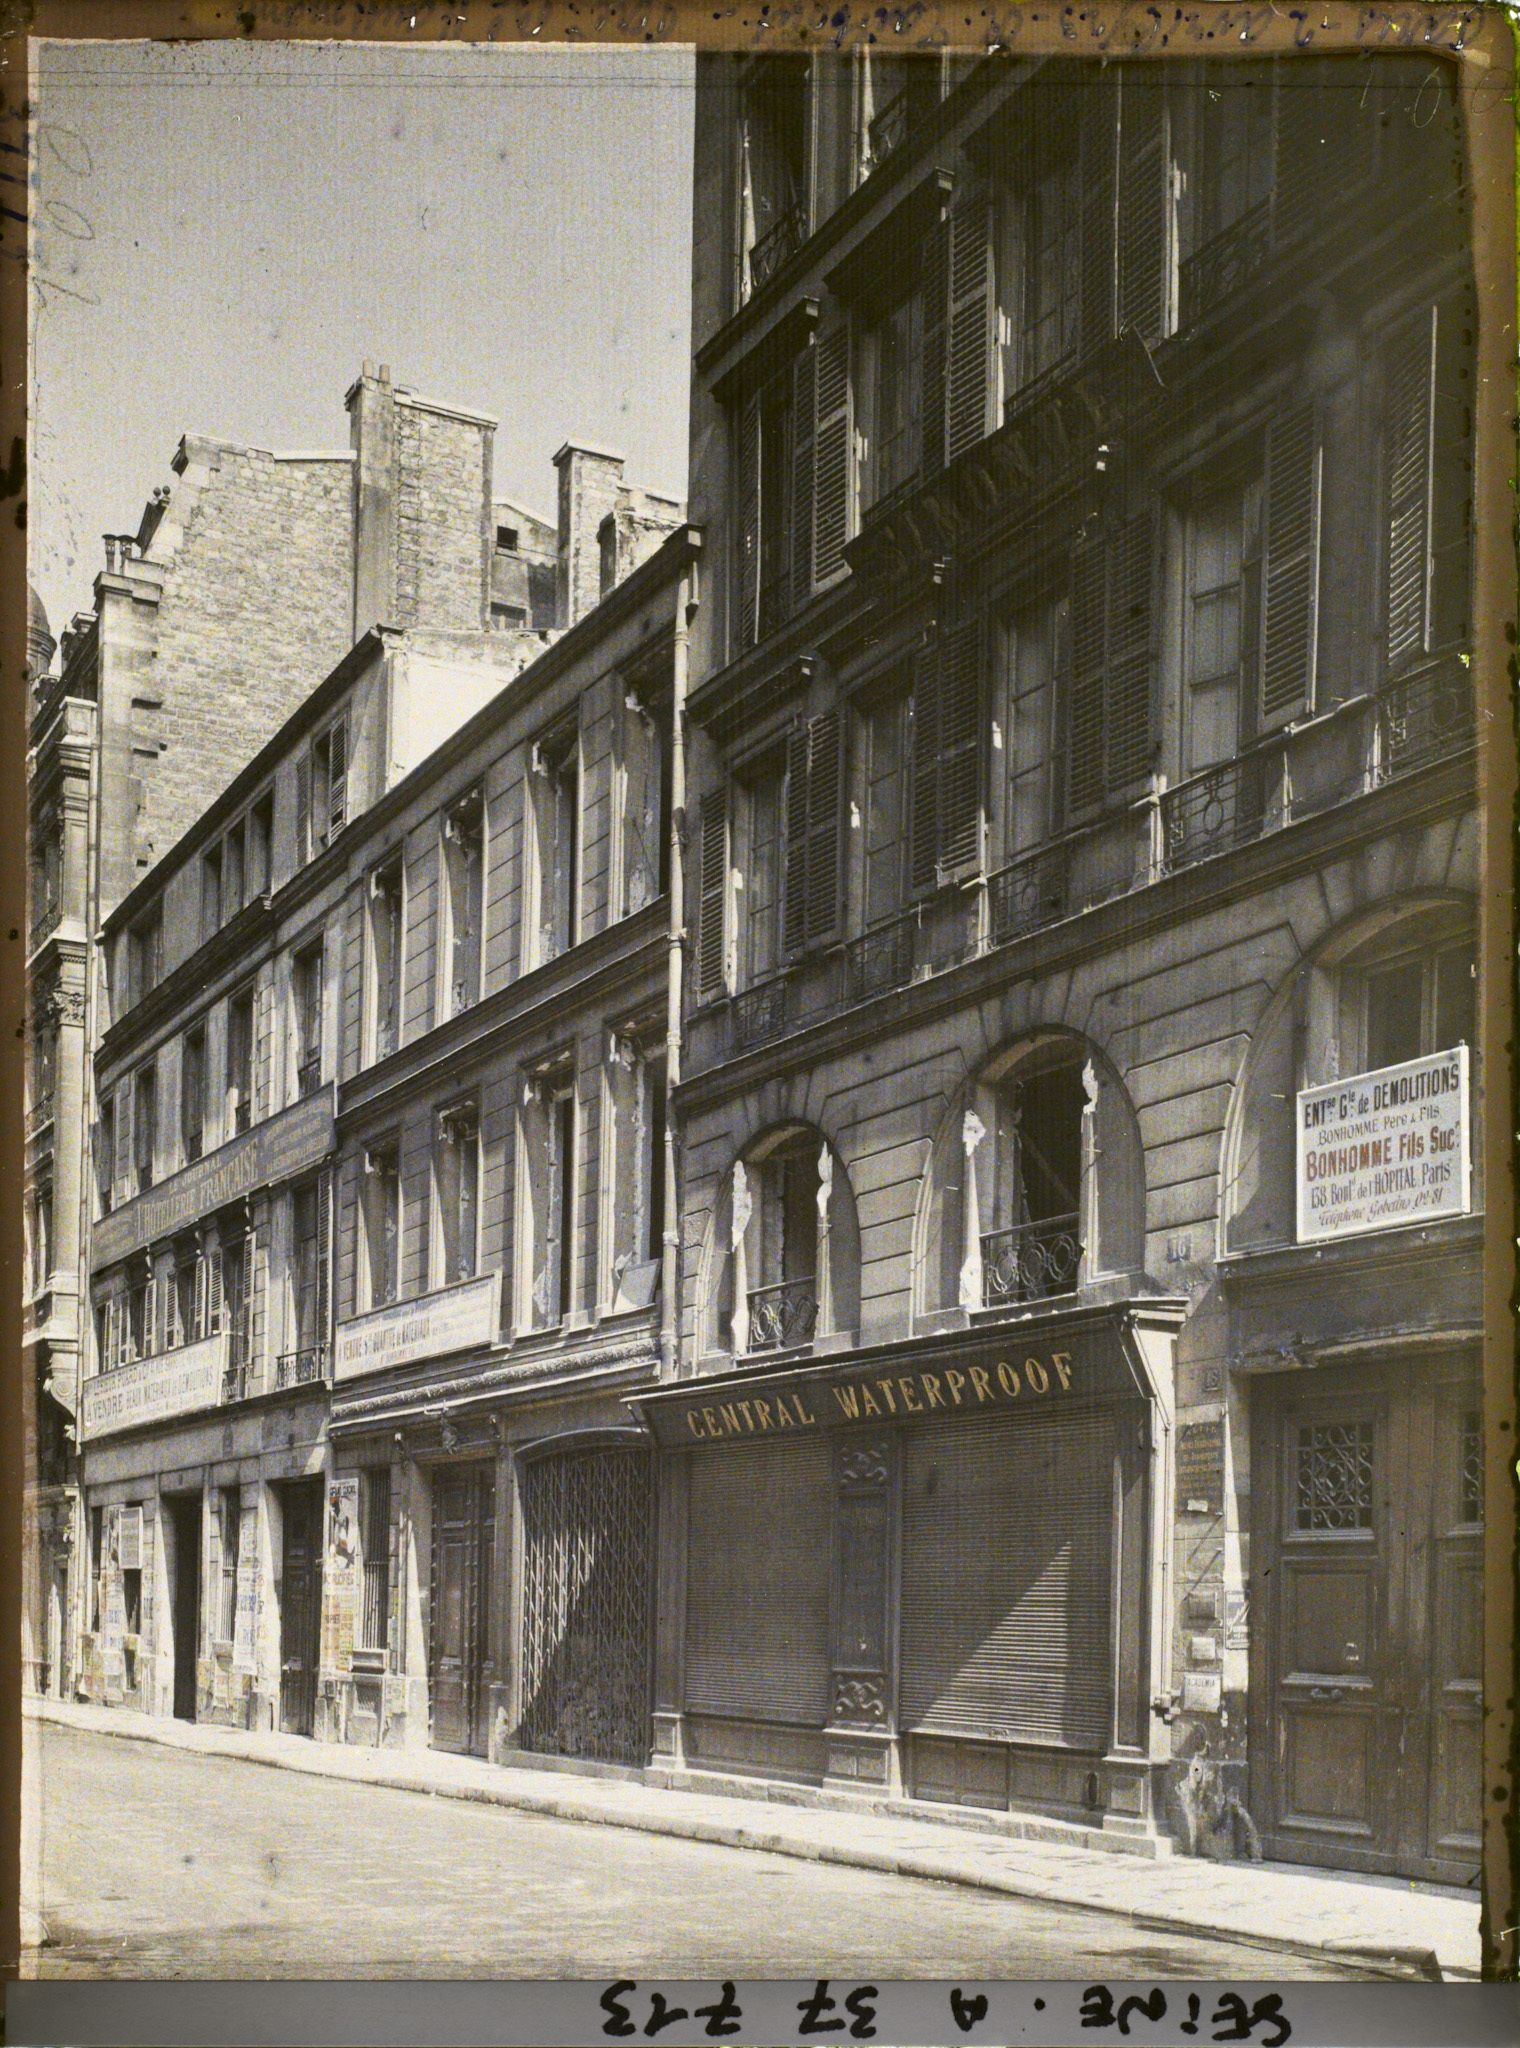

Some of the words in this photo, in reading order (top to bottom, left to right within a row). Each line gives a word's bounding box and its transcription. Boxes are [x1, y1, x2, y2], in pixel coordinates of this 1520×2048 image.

[1317, 1118, 1378, 1146] BONHOMME
[1419, 1105, 1440, 1122] Fils
[1358, 1093, 1369, 1114] de
[1306, 1137, 1392, 1182] BONHOMME
[1399, 1131, 1424, 1162] Fils
[1357, 1182, 1368, 1199] de
[1422, 1161, 1451, 1185] Paris
[688, 1393, 815, 1439] CENTRAL
[832, 1352, 1073, 1420] WATERPROOF
[599, 1980, 742, 2039] 713
[796, 1980, 879, 2038] 37
[949, 1987, 989, 2032] A
